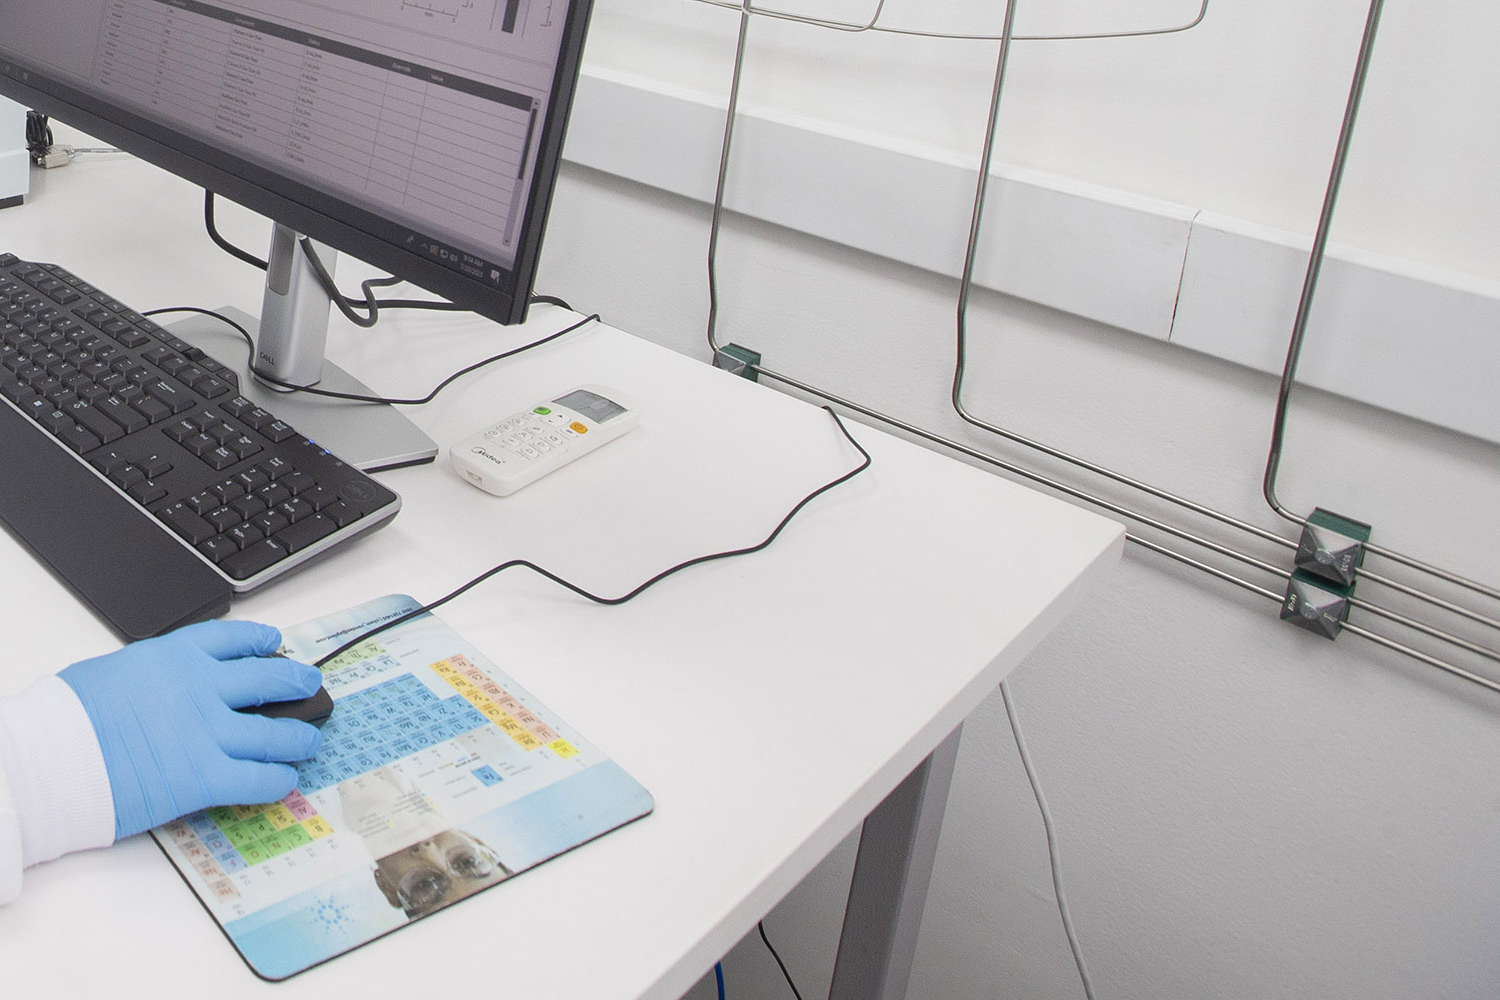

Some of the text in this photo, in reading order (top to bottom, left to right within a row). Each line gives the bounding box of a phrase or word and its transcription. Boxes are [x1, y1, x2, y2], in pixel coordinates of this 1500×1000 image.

[260, 352, 276, 366] DELL
[476, 449, 502, 465] Midea
[266, 540, 278, 549] Enter
[382, 658, 393, 666] La
[329, 678, 341, 686] Nd
[386, 707, 395, 715] W
[348, 720, 360, 728] Os
[399, 721, 414, 729] Mo
[363, 735, 375, 744] Ru
[344, 743, 357, 751] Rh
[396, 743, 411, 752] Mn
[326, 750, 338, 758] Pd
[380, 751, 391, 759] Fe
[361, 758, 372, 767] Co
[321, 773, 333, 781] Cu
[301, 780, 313, 790] Zn
